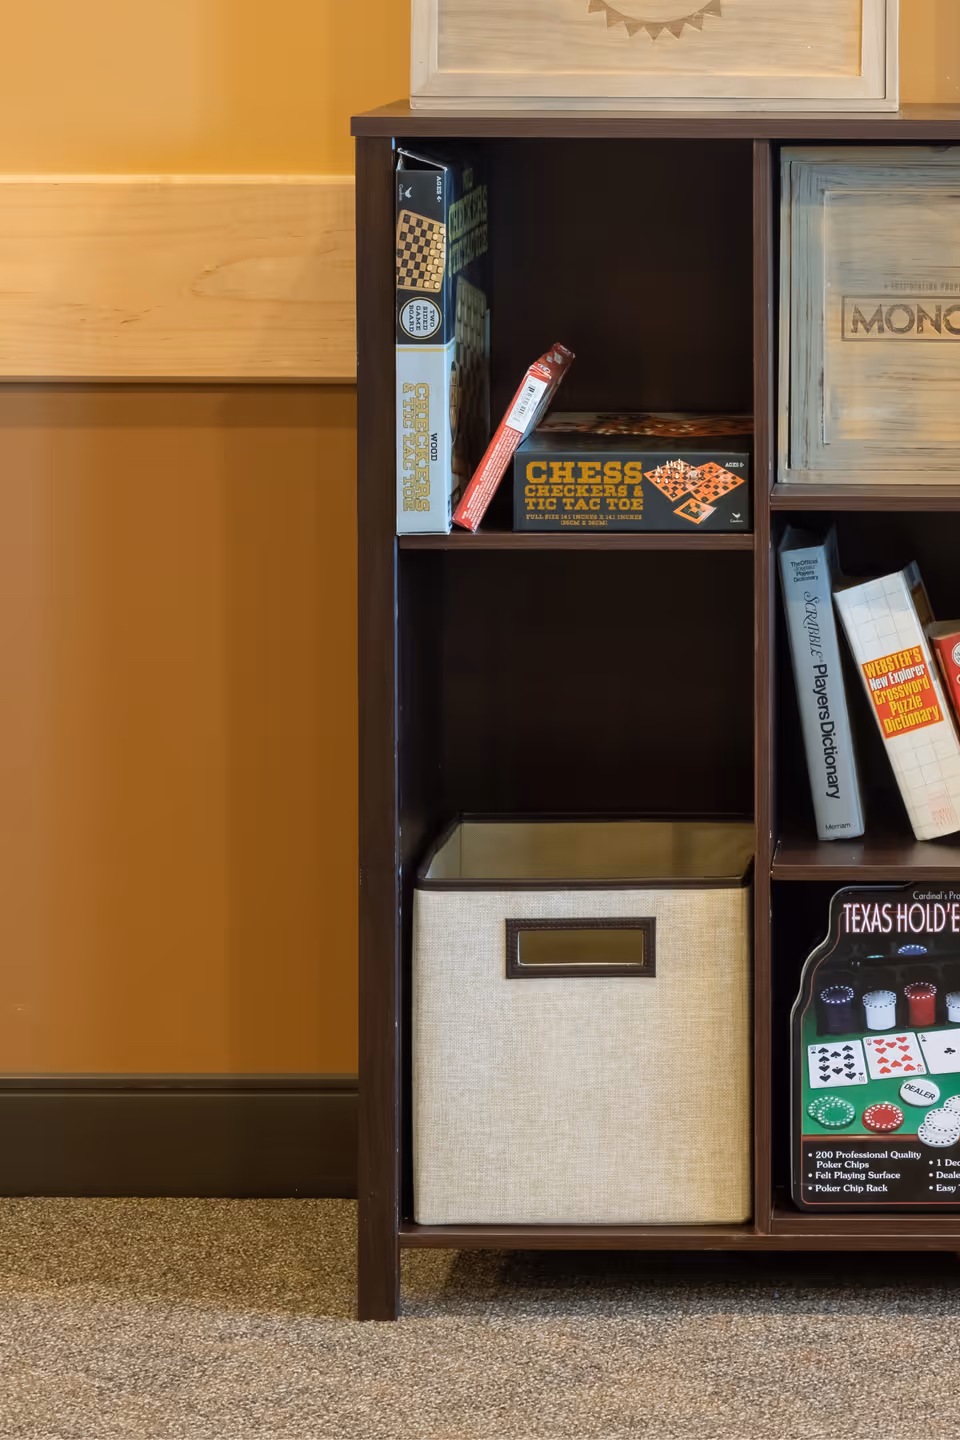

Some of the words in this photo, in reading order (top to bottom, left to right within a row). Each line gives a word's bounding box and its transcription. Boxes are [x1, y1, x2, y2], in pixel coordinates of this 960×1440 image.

[403, 397, 415, 428] TIC
[403, 434, 415, 470] TAC
[415, 383, 430, 512] CHECKERS
[526, 461, 643, 484] CHESS
[403, 474, 415, 511] TOE
[525, 485, 627, 497] CHECKERS
[632, 485, 644, 497] &
[525, 498, 556, 510] TIC
[562, 498, 601, 510] TAC
[606, 498, 643, 510] TOE
[803, 591, 823, 659] SCRABBLE
[864, 647, 922, 678] WEBSTER'S
[869, 675, 889, 691] New
[888, 664, 925, 684] Explorer
[873, 674, 930, 705] Crossword
[813, 663, 830, 720] Players
[889, 694, 923, 716] Puzzle
[883, 705, 940, 734] Dictionary
[820, 721, 841, 800] Dictionary
[913, 891, 948, 900] Cardinal's
[843, 903, 892, 933] TEXAS
[903, 1083, 936, 1100] DEALER
[815, 1151, 833, 1159] 200
[836, 1151, 888, 1159] Professional
[890, 1151, 921, 1160] Quality
[816, 1161, 842, 1169] Poker
[844, 1161, 869, 1170] Chips
[815, 1171, 831, 1179] Felt
[834, 1171, 866, 1180] Playing
[868, 1171, 901, 1179] Surface
[815, 1184, 841, 1192] Poker
[843, 1184, 864, 1193] Chip
[866, 1184, 888, 1192] Rack
[936, 1184, 956, 1193] Easy
